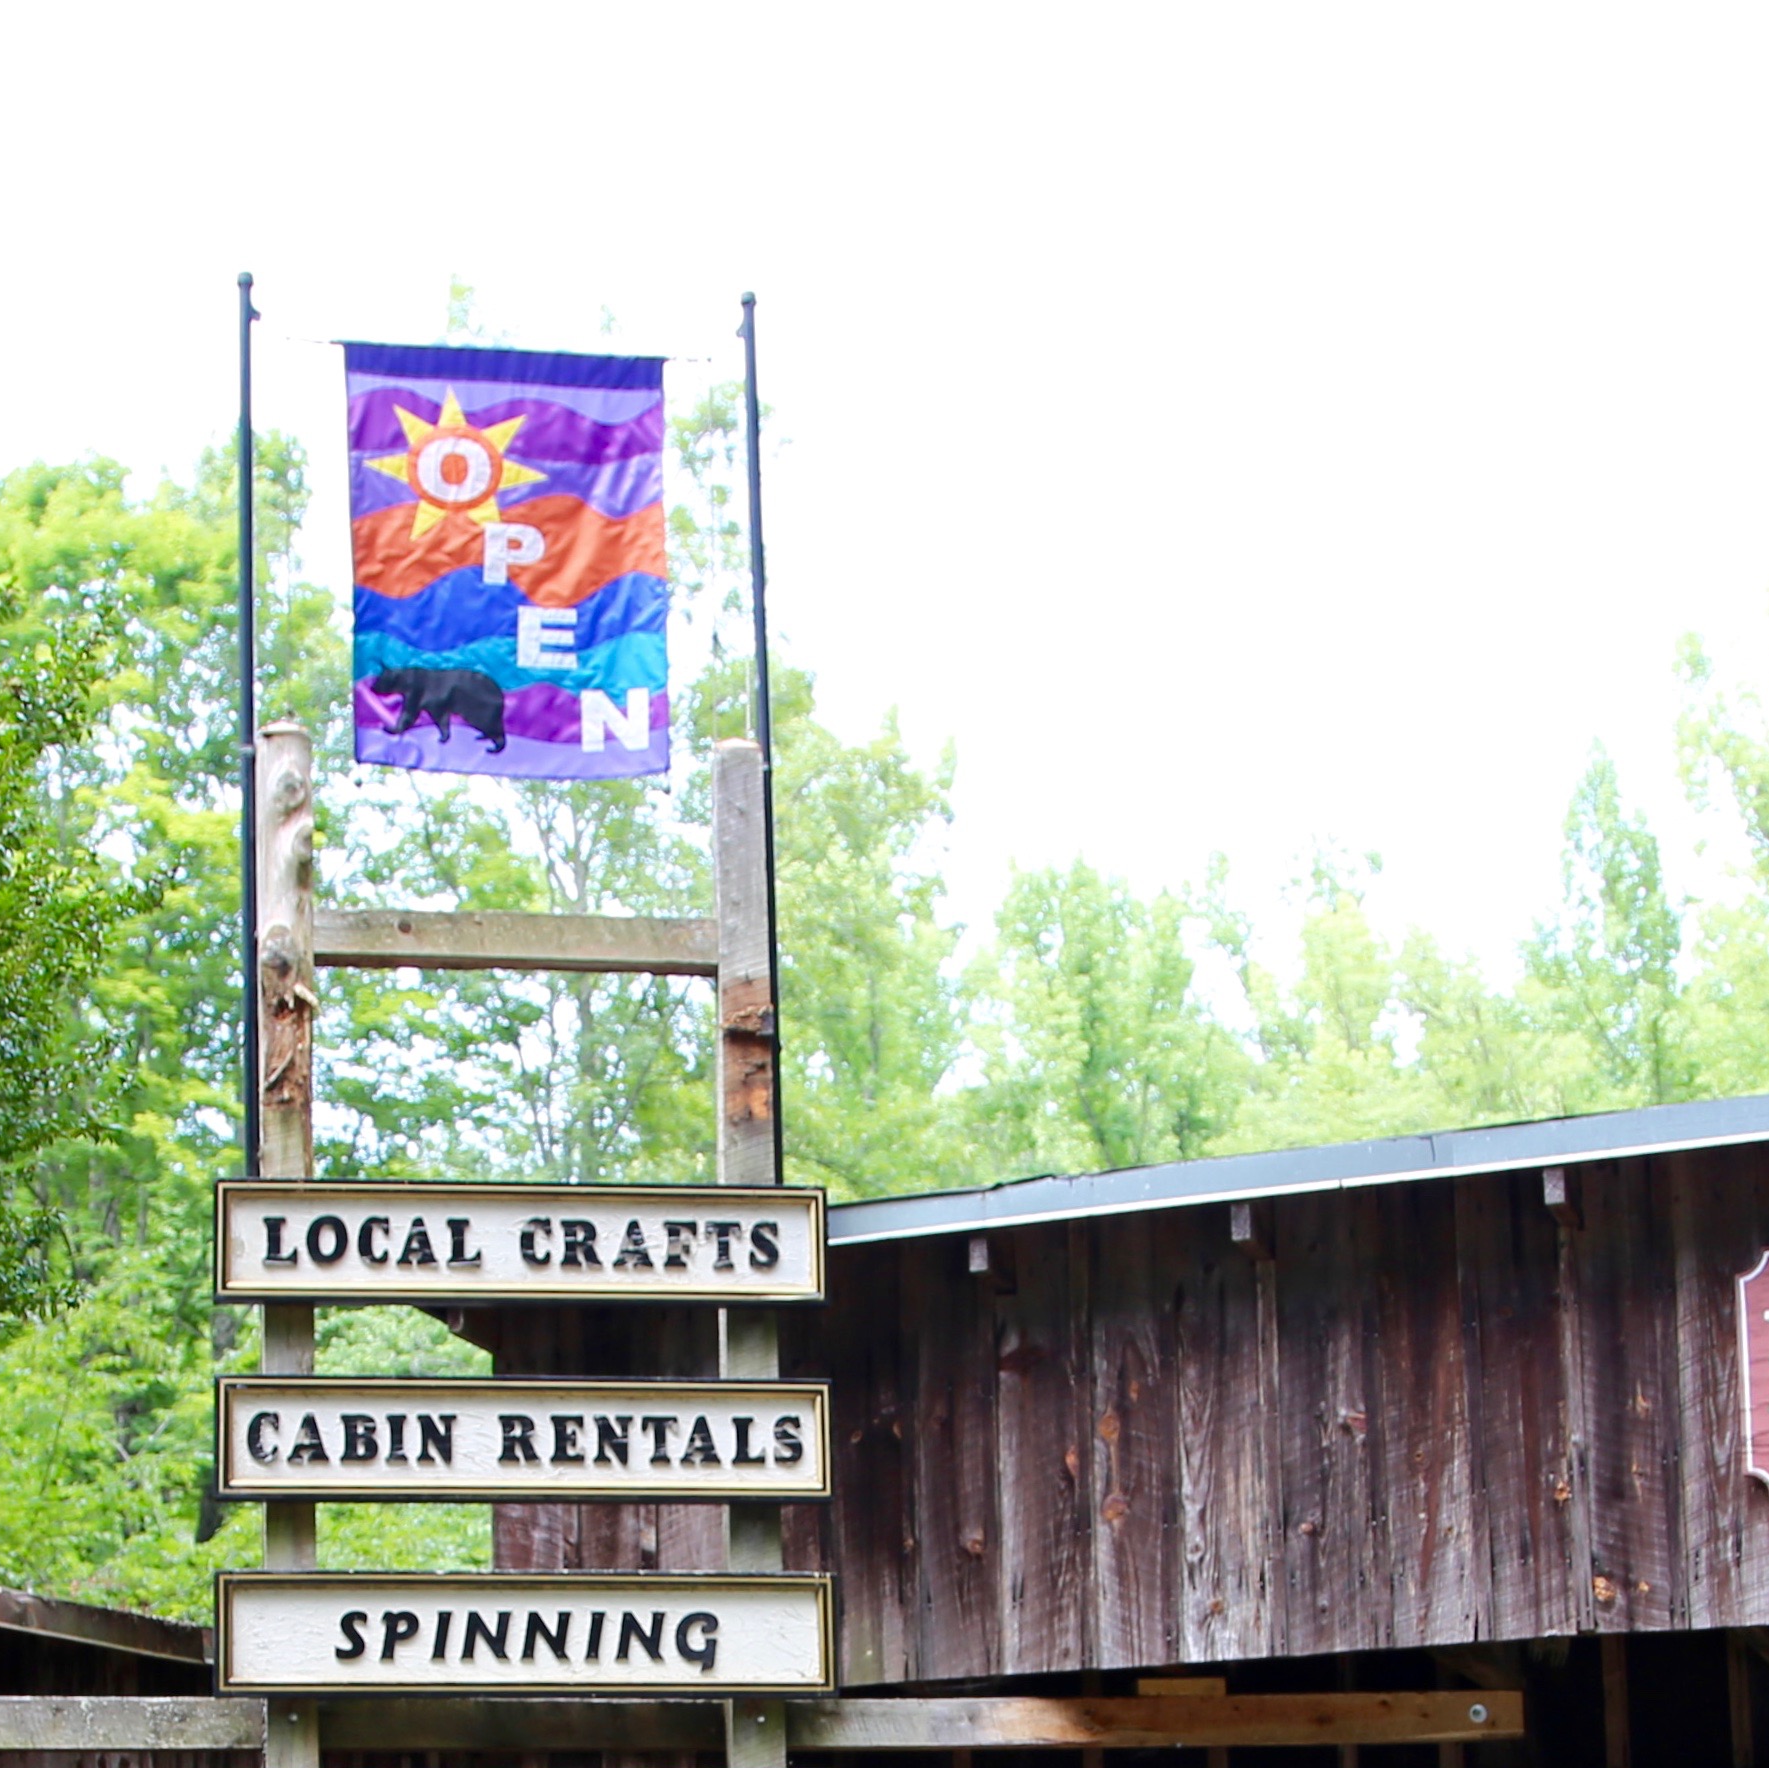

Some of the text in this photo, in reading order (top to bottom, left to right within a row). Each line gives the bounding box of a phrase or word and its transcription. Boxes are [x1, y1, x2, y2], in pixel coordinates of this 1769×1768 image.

[416, 436, 649, 752] OPEN
[262, 1216, 781, 1271] LOCAL CRAFTS
[246, 1412, 805, 1466] CABIN RENTALS
[335, 1610, 721, 1672] SPINNING
